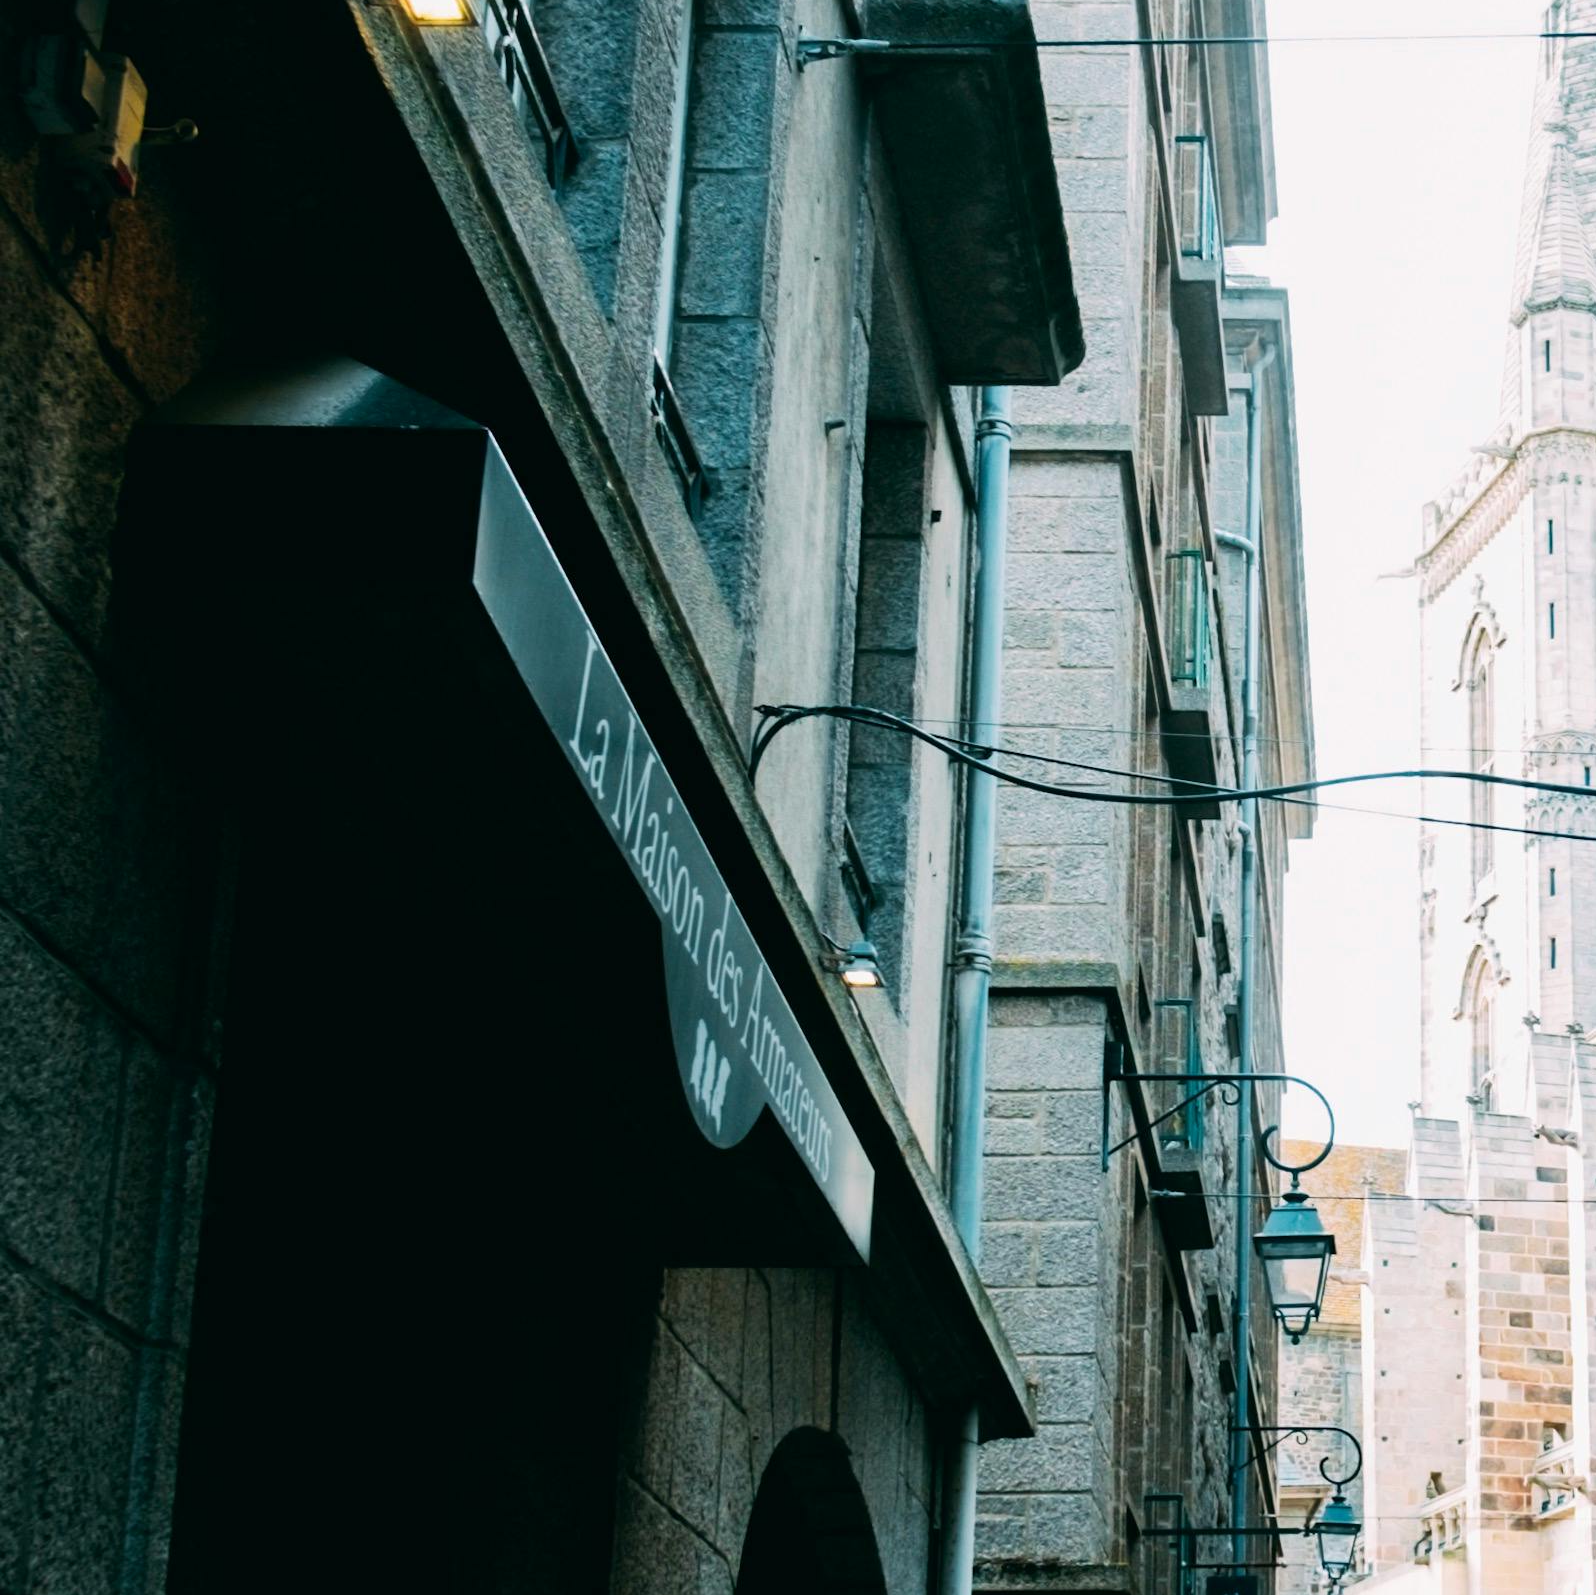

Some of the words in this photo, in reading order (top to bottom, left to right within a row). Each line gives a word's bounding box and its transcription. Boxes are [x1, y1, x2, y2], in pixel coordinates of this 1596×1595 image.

[568, 629, 609, 800] La
[611, 709, 705, 966] Maison
[706, 891, 744, 1029] des
[740, 961, 833, 1184] Armateurs
